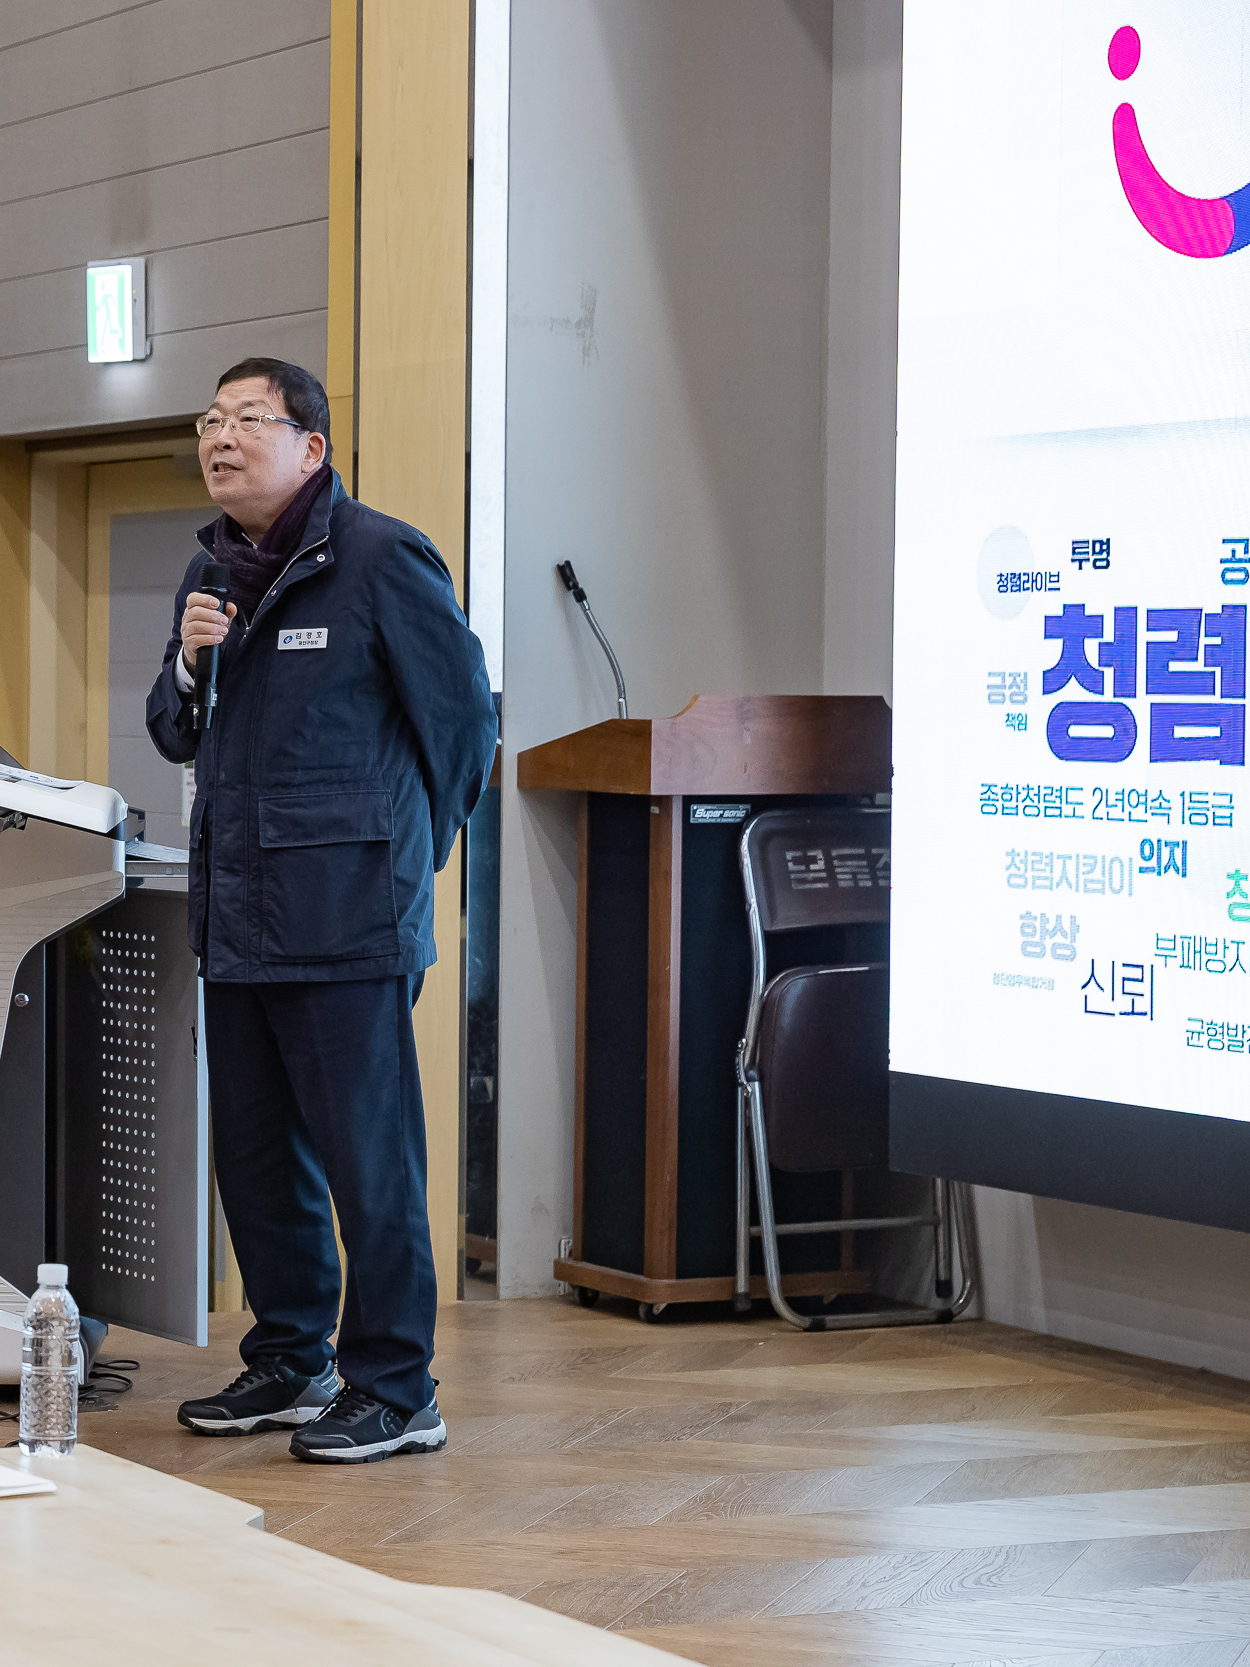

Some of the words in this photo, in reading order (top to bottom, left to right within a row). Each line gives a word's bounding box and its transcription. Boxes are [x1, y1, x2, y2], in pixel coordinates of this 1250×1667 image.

[1071, 537, 1111, 570] 투명
[996, 571, 1061, 594] 청렴라이브
[986, 671, 1029, 706] 긍정
[1042, 603, 1247, 767] 청렴
[1005, 712, 1028, 732] 책임
[695, 808, 723, 819] Super
[979, 782, 1085, 820] 종합청렴도
[1091, 786, 1172, 826] 2년연속
[1179, 790, 1235, 828] 1등급
[1005, 847, 1134, 898] 청렴지킴이
[1138, 837, 1188, 878] 의지
[1019, 910, 1081, 963] 향상
[1080, 957, 1154, 1022] 신뢰
[1185, 1017, 1250, 1055] 균형발
